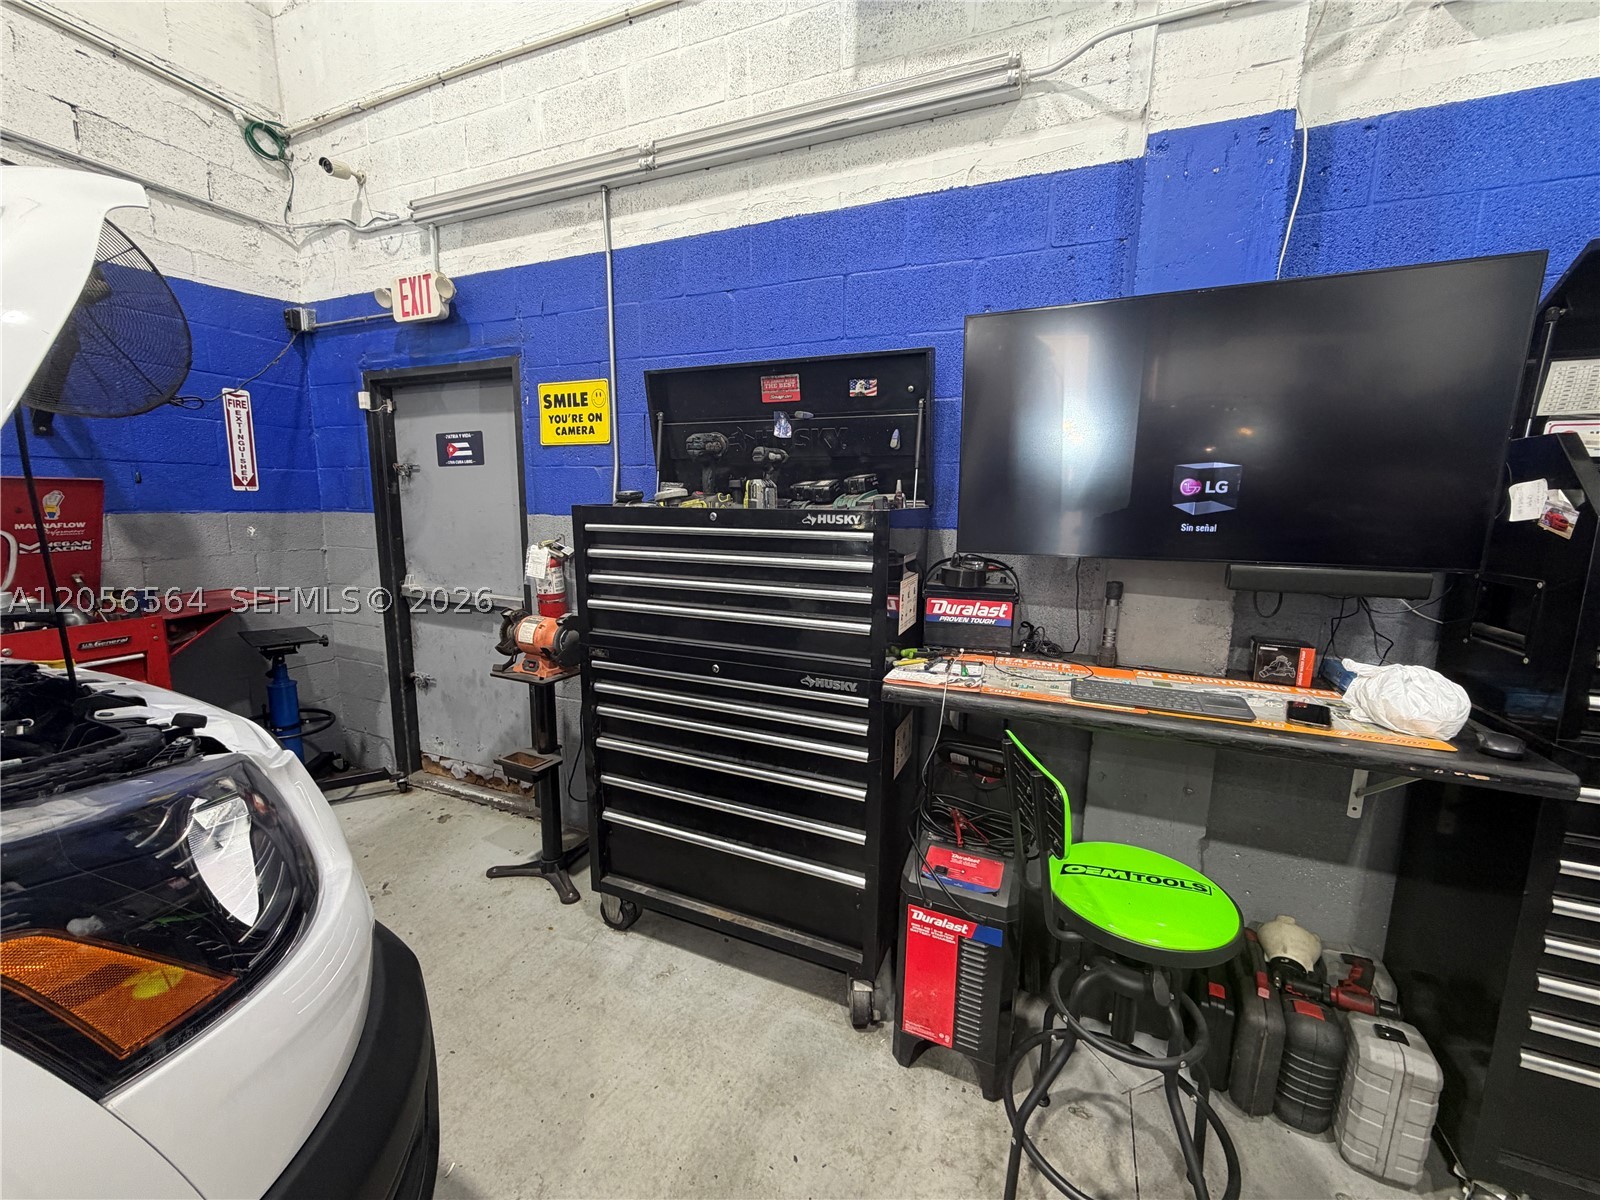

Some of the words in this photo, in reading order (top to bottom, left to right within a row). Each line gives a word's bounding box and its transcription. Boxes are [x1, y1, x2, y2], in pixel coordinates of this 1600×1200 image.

[398, 273, 432, 318] EXIT
[227, 398, 248, 410] FIRE
[543, 391, 589, 410] SMILE
[548, 413, 584, 424] YOU'RE
[587, 412, 603, 422] ON
[555, 425, 596, 436] CAMERA
[235, 409, 249, 482] EXTINGUISHER
[1205, 480, 1229, 494] LG
[817, 514, 861, 525] HUSKY
[1180, 523, 1194, 532] Sin
[1195, 523, 1218, 533] señal
[930, 599, 1008, 618] Duralast
[938, 615, 970, 623] PROVEN
[970, 617, 996, 625] TOUGH
[814, 676, 858, 693] HUSKY
[1136, 670, 1163, 678] AIR
[1167, 674, 1292, 692] CONDITIONING
[1296, 688, 1342, 699] SYST
[910, 908, 969, 935] Duralast
